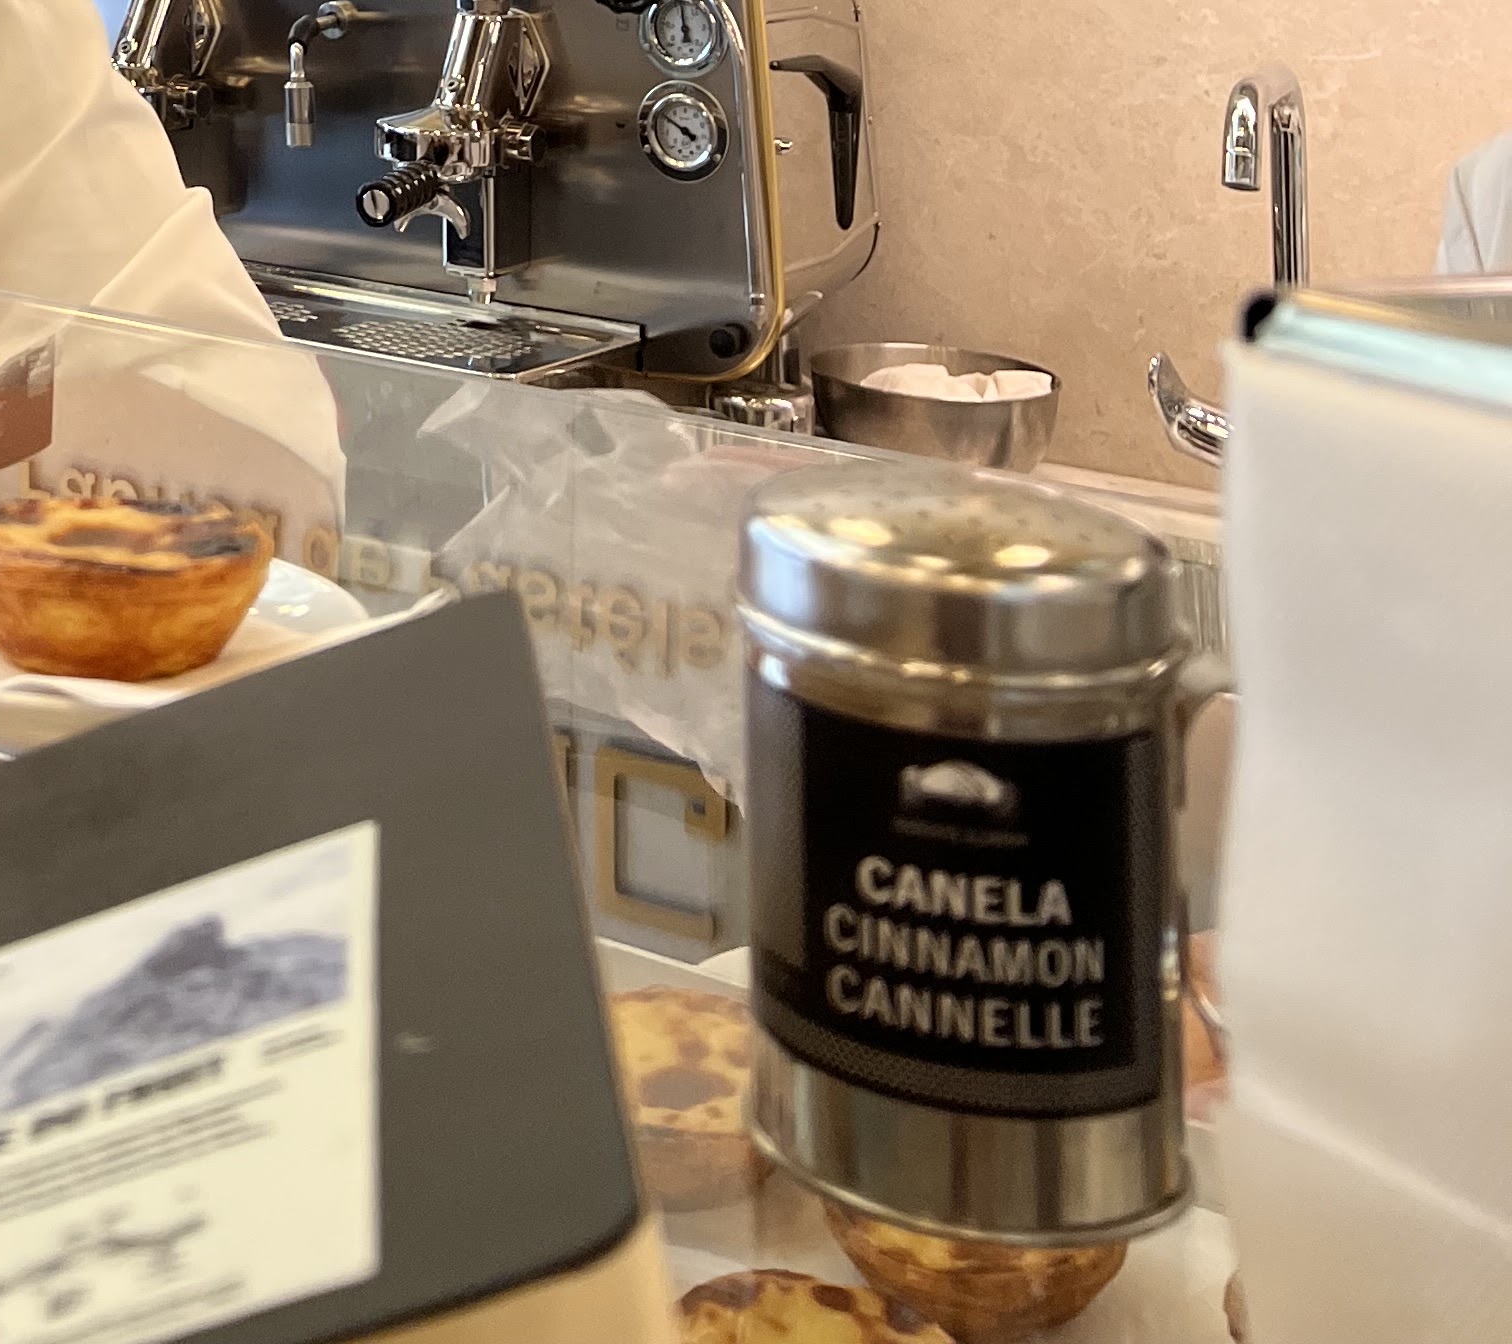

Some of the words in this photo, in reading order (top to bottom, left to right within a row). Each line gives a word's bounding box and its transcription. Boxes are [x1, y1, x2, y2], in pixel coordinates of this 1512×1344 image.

[854, 854, 1073, 927] CANELA
[822, 902, 1105, 989] CINNAMON
[825, 963, 1105, 1050] CANNELLE
